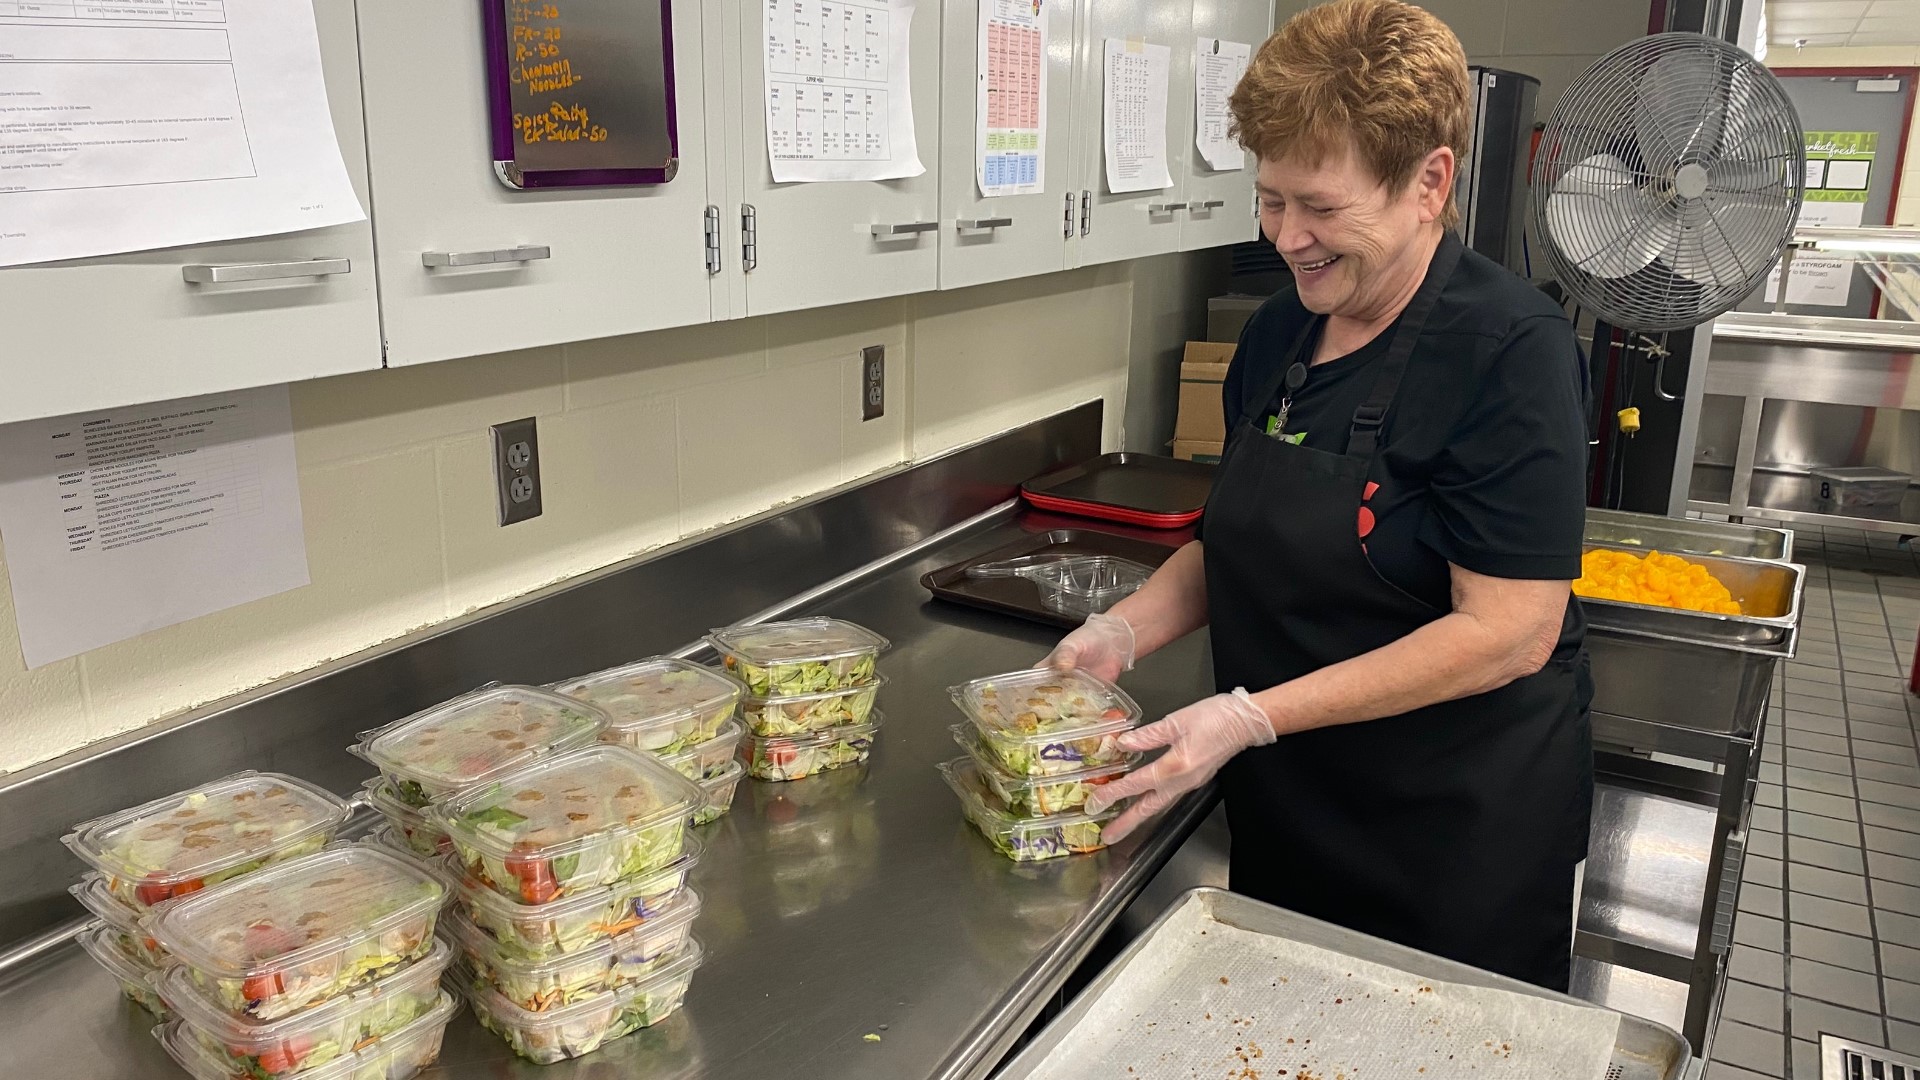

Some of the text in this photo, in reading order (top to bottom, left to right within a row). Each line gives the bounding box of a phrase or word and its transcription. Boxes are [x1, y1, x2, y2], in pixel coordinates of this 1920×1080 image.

[58, 470, 85, 479] WEDNESDAY
[59, 478, 83, 487] THURSDAY
[1821, 482, 1830, 498] 8
[68, 530, 95, 539] WEDNESDAY
[69, 537, 93, 545] THURSDAY
